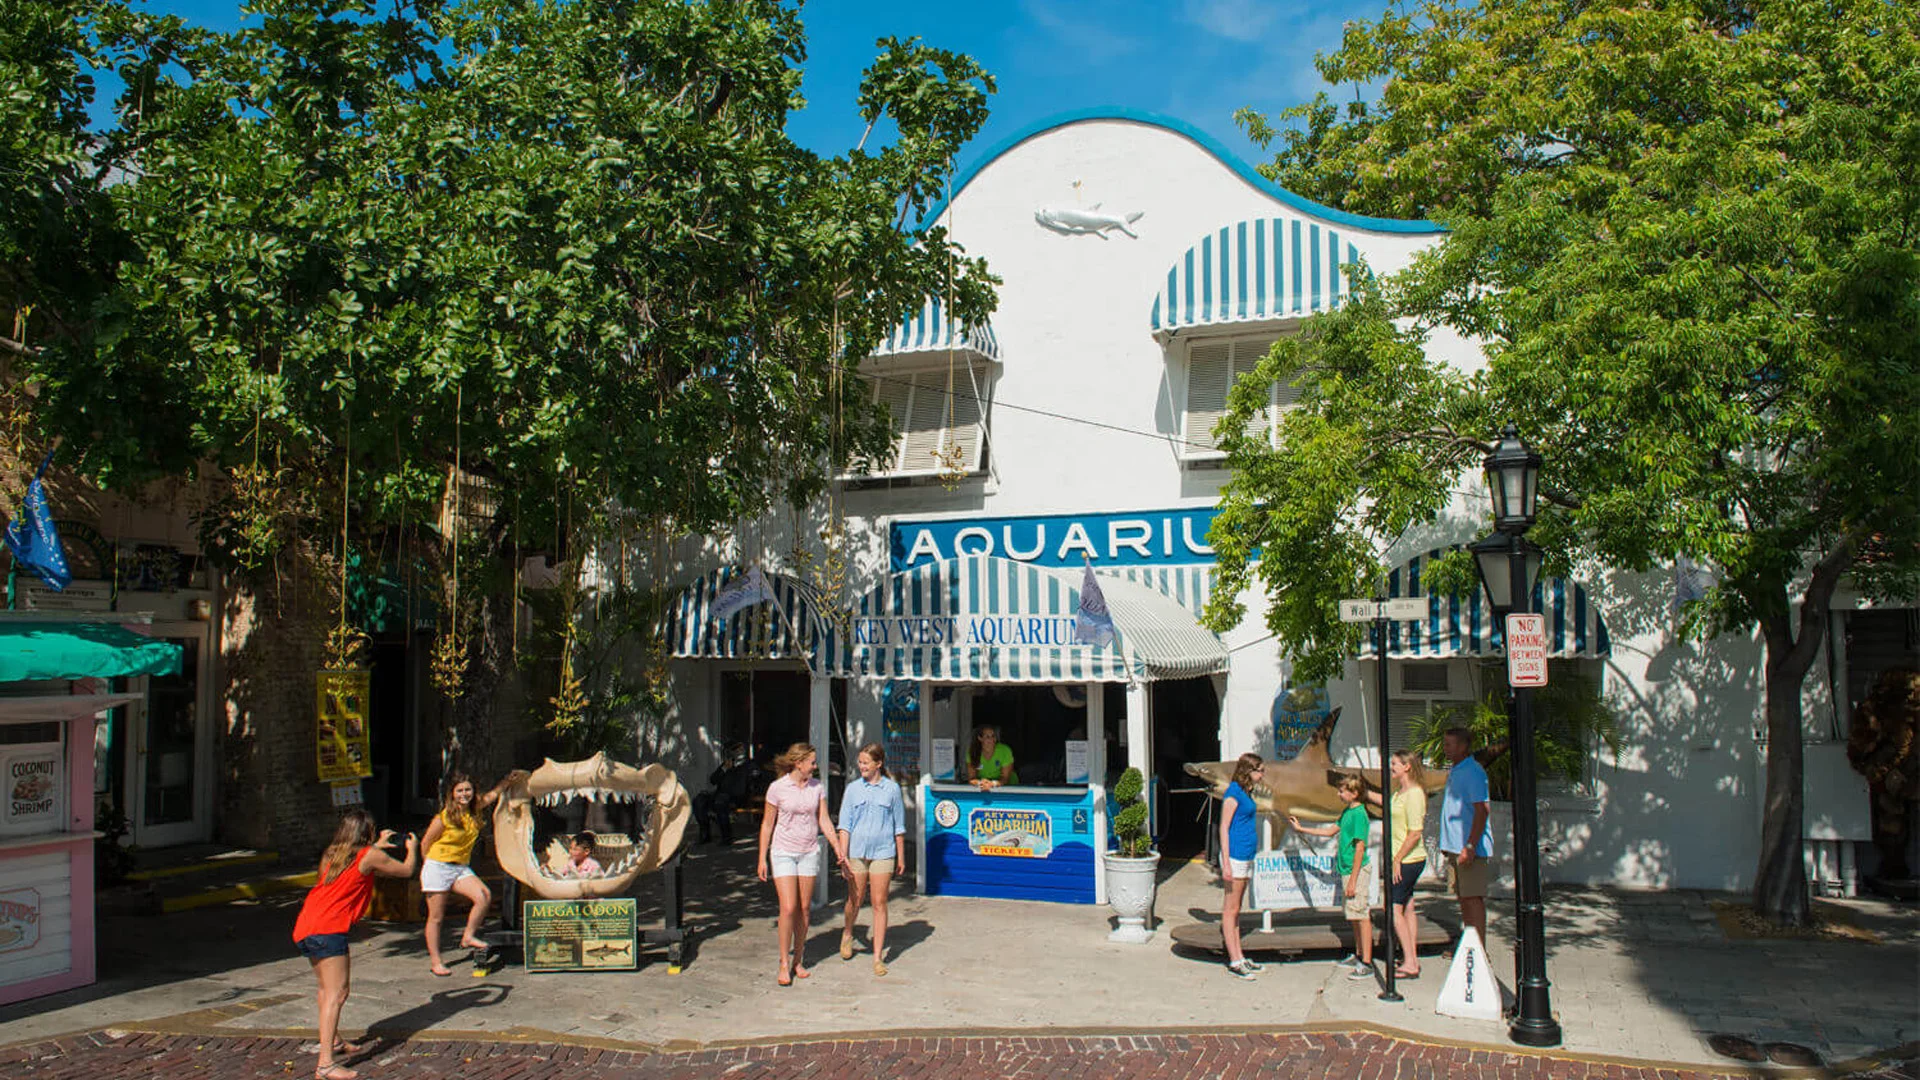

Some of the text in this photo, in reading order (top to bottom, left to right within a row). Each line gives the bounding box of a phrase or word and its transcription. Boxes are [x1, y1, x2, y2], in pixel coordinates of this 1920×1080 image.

[1350, 605, 1372, 617] Wall
[854, 619, 892, 645] KEY
[899, 618, 957, 645] WEST
[1518, 620, 1535, 632] NO
[1511, 634, 1543, 647] PARKING
[1511, 650, 1544, 660] BETWEEN
[1517, 663, 1540, 672] SIGNS
[12, 760, 56, 778] COCONUT
[11, 799, 53, 816] SHRIMP
[984, 811, 1037, 820] KEY WEST
[973, 817, 1048, 840] AQUARIUM
[983, 846, 1031, 856] TICKETS
[531, 904, 629, 918] MEGALODON
